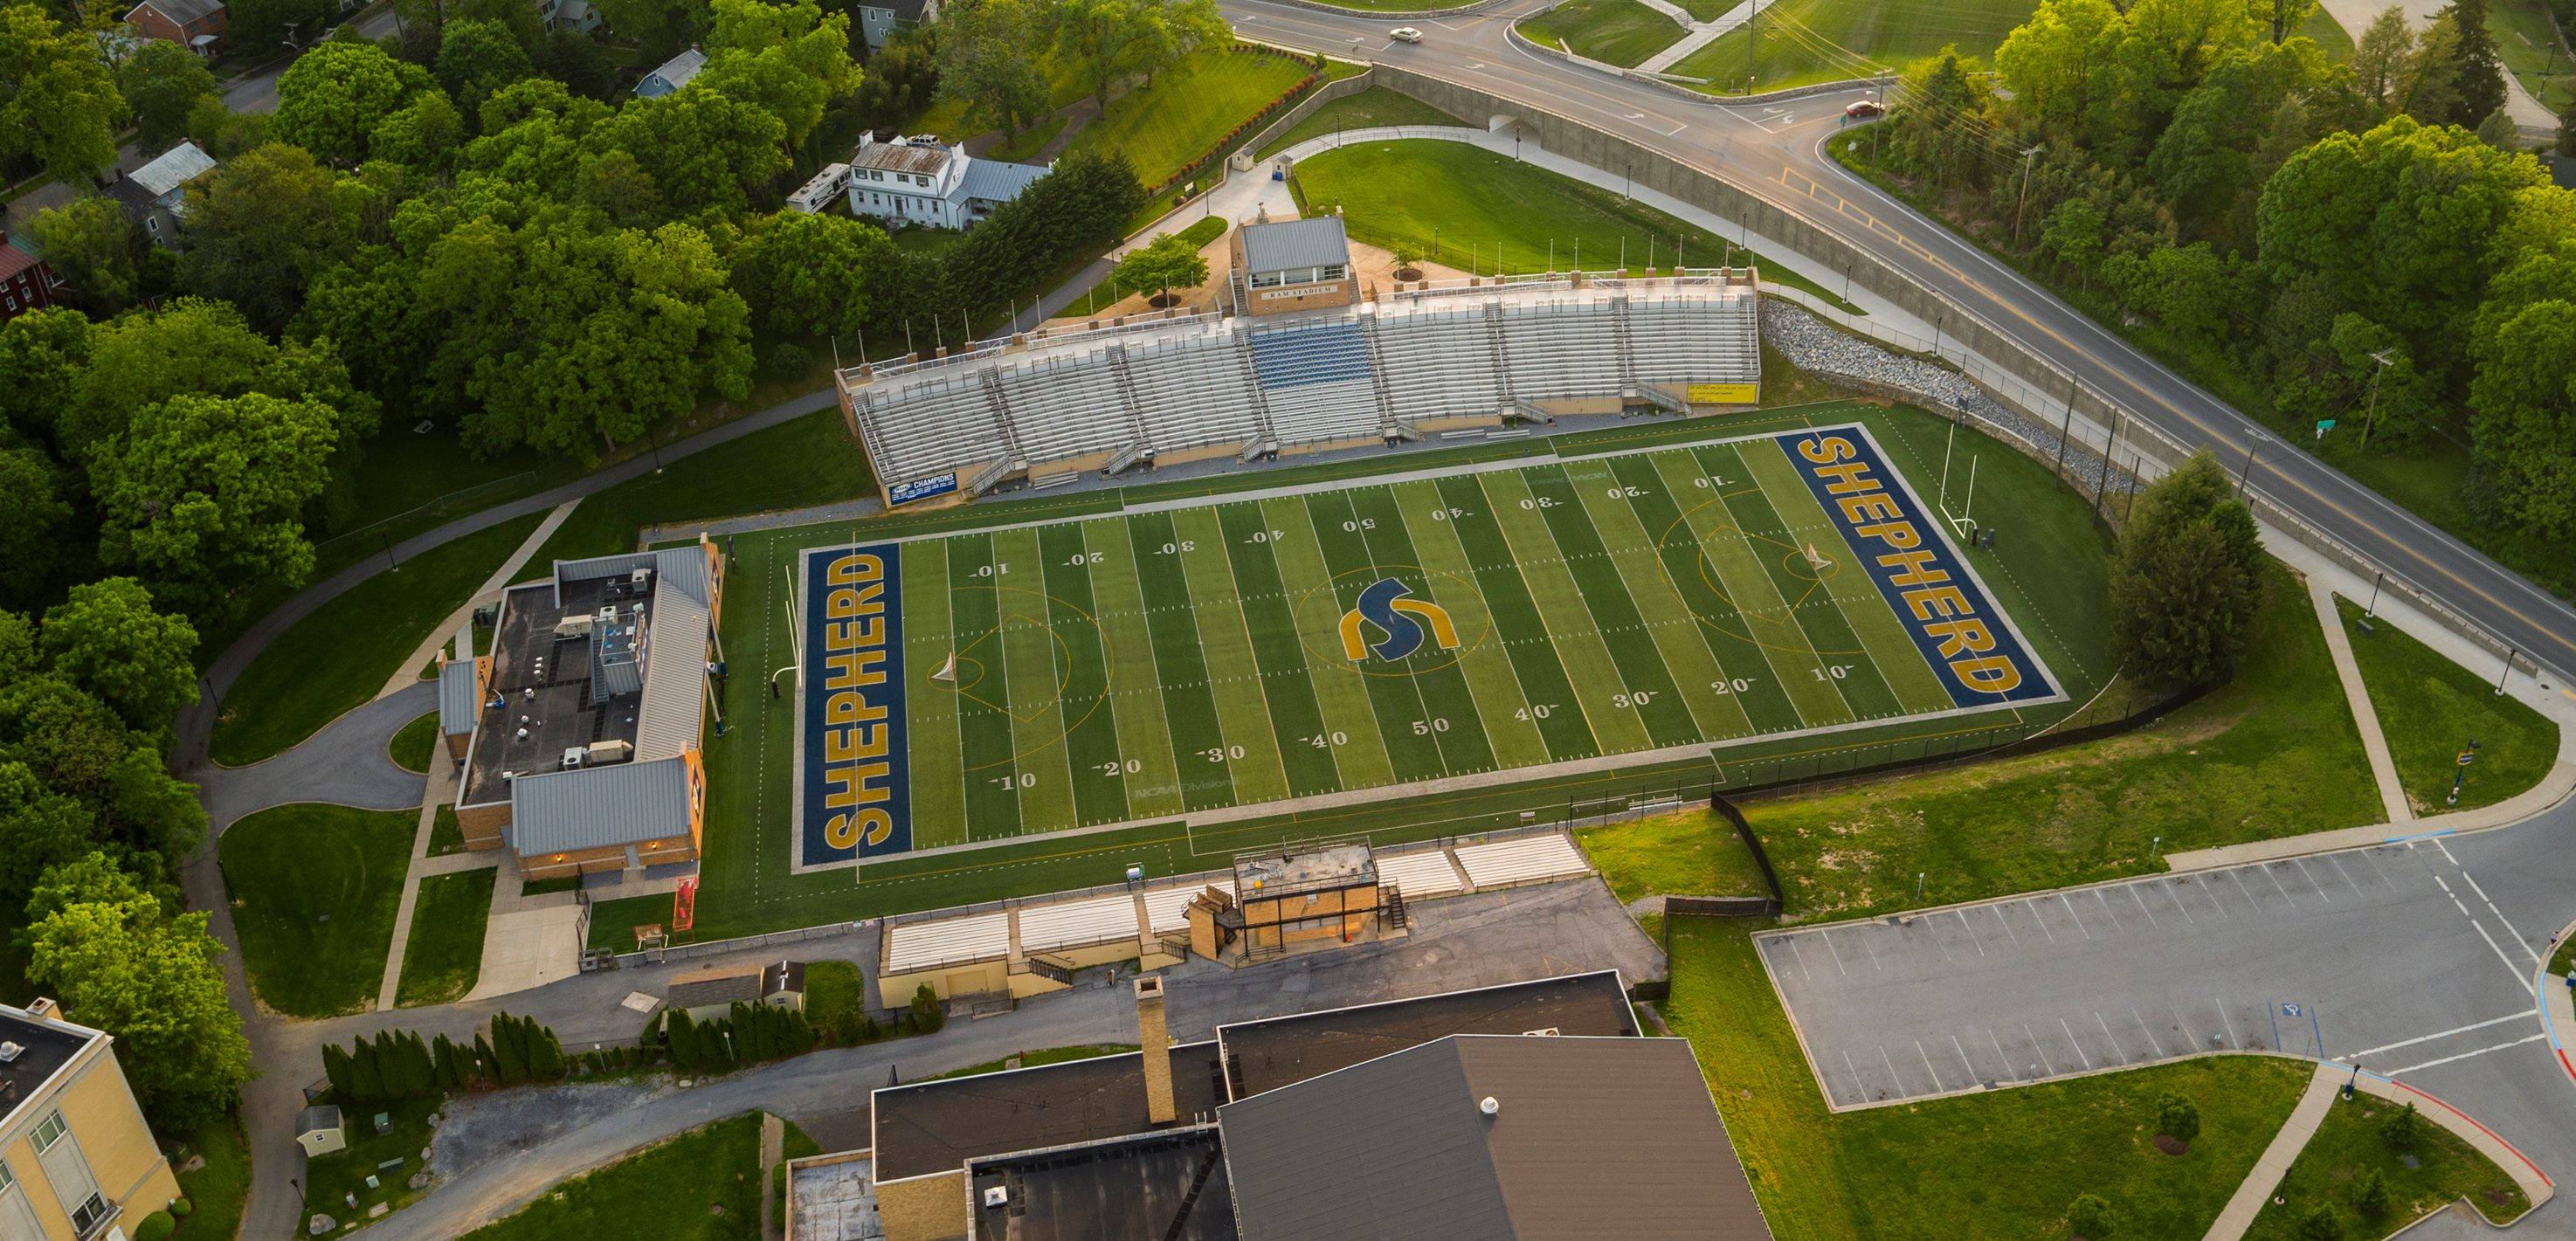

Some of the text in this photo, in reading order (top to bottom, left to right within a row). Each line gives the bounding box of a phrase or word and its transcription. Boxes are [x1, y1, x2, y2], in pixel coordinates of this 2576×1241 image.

[1292, 286, 1331, 295] STADIUM
[913, 473, 954, 489] CHAMPIONS
[1694, 475, 1726, 488] 10
[1607, 486, 1640, 499] 20
[1520, 497, 1553, 510] 30
[1432, 507, 1464, 521] 40
[1343, 518, 1377, 532] 50
[1253, 529, 1286, 543] 40
[1162, 541, 1195, 555] 30
[1071, 551, 1105, 566] 20
[1797, 436, 2022, 694] SHEPHERD
[978, 563, 1009, 577] 10
[1812, 665, 1847, 682] 10
[1710, 679, 1749, 695] 20
[824, 553, 893, 850] SHEPHERD
[1612, 692, 1650, 708] 30
[1514, 705, 1550, 721] 40
[1412, 718, 1449, 735] 50
[1310, 732, 1348, 748] 40
[1207, 746, 1246, 762] 30
[1103, 759, 1142, 776] 20
[1001, 773, 1037, 790] 10
